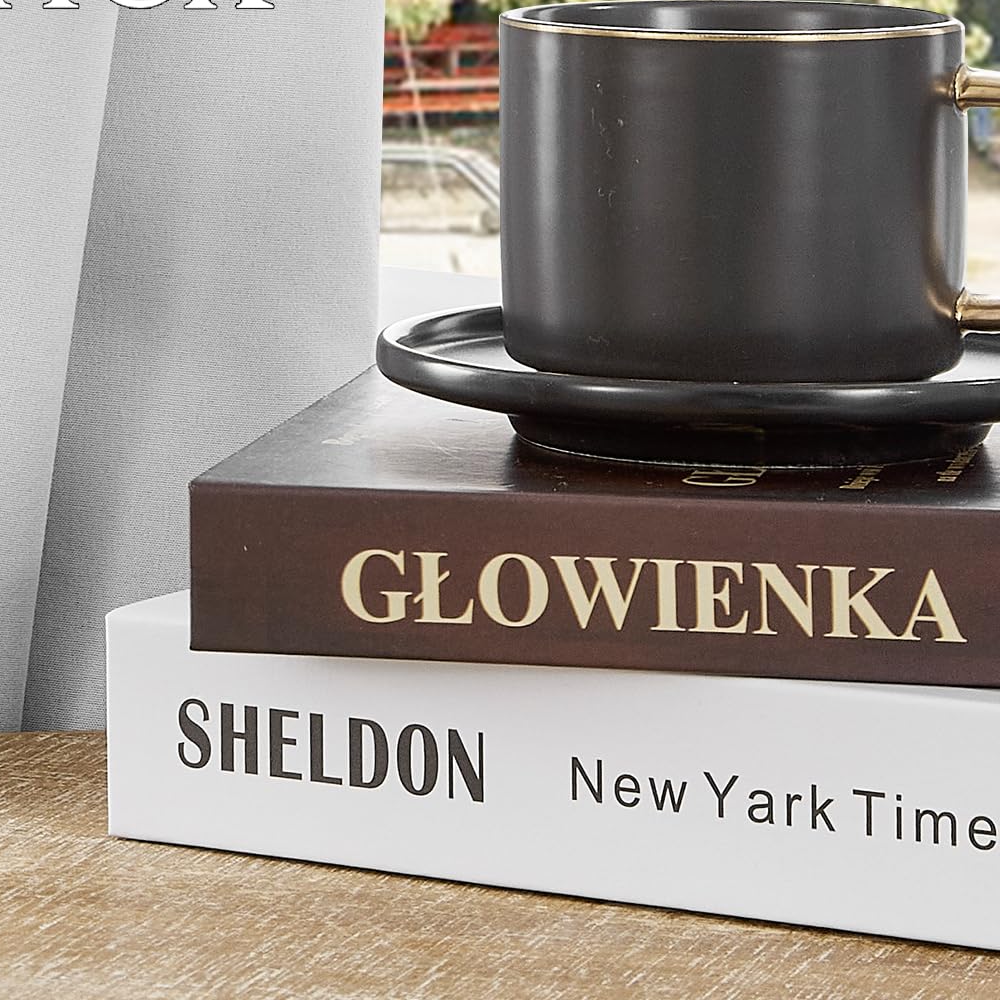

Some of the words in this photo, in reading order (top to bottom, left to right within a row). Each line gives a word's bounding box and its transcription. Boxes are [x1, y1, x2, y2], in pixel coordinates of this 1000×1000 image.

[340, 549, 967, 643] GŁOWIENKA
[177, 699, 485, 802] SHELDON
[570, 756, 687, 813] New
[704, 771, 836, 832] Yark
[852, 789, 998, 851] Time
